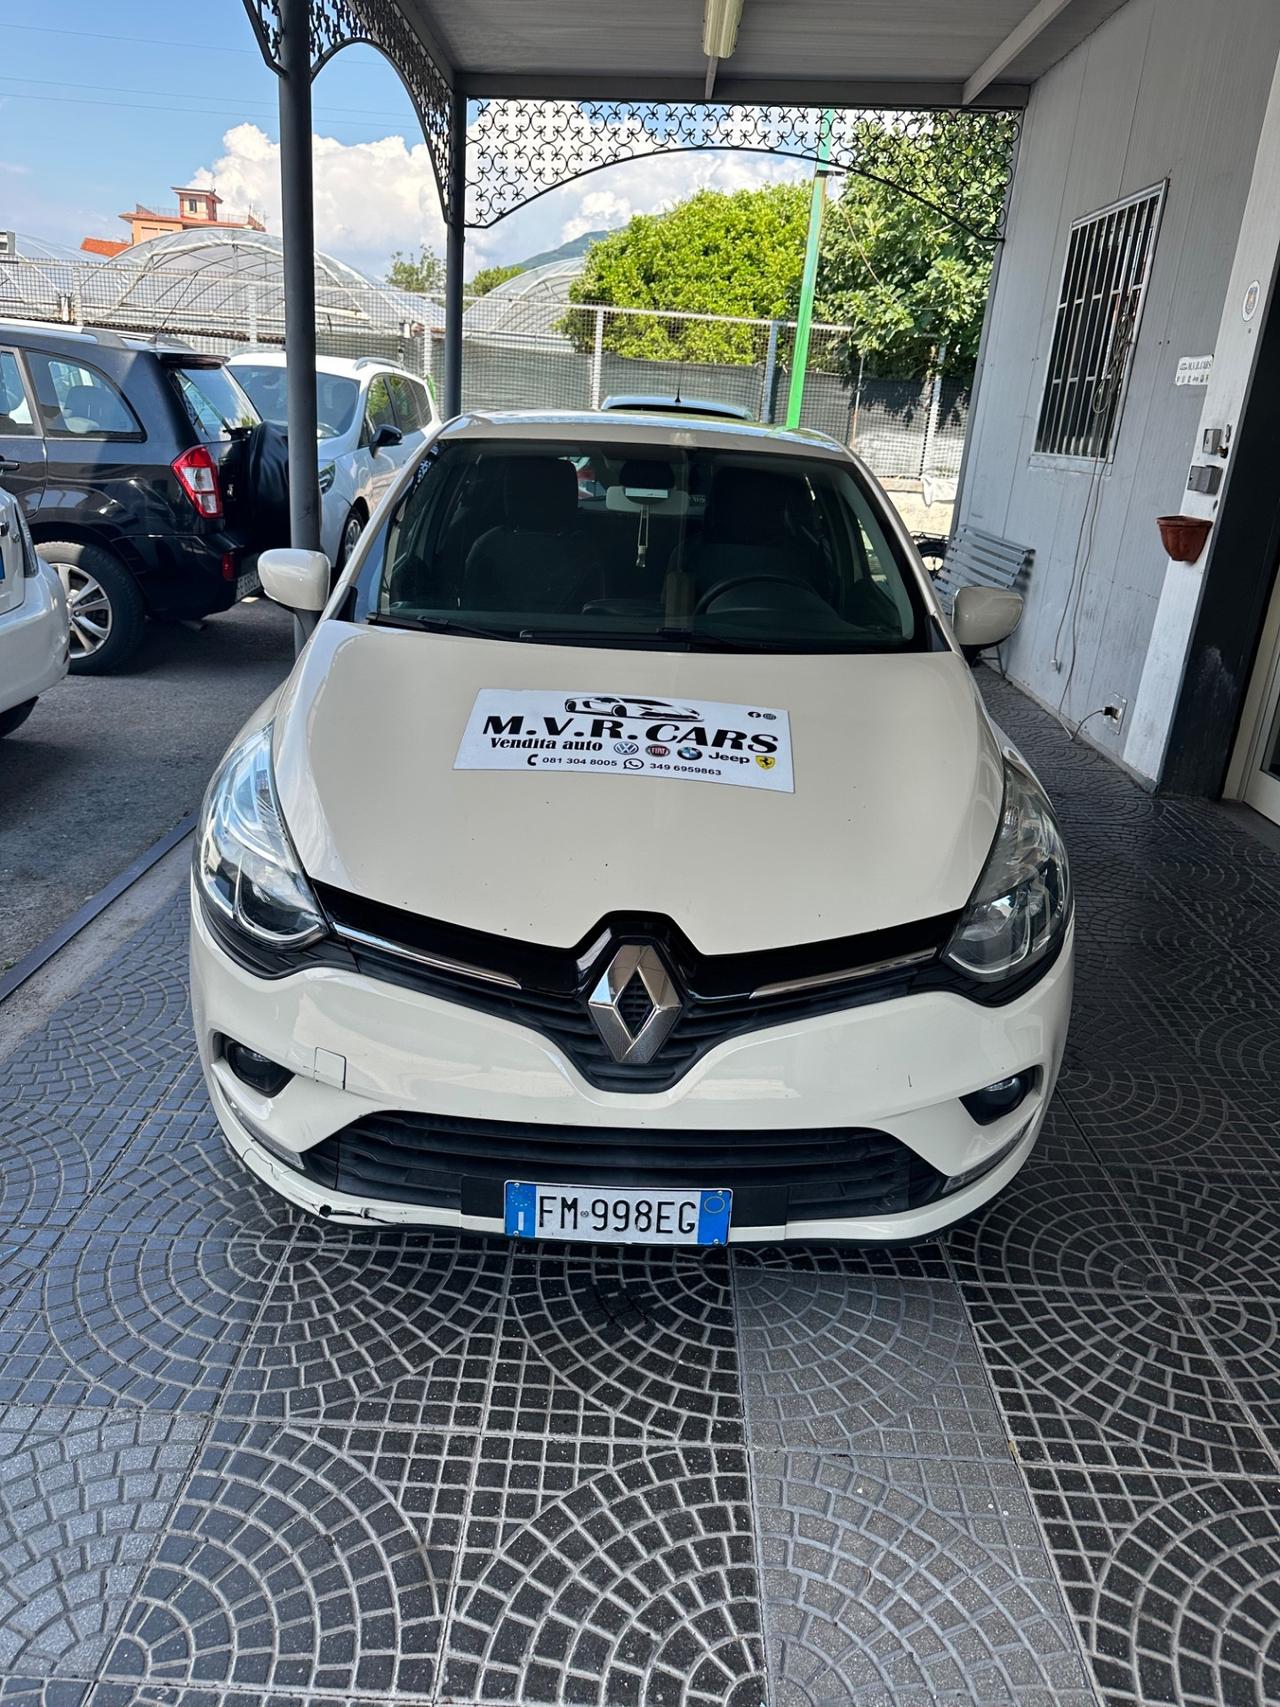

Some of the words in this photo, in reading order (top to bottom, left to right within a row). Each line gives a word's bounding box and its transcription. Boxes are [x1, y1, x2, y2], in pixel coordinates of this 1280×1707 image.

[491, 737, 556, 750] Vendita
[562, 740, 603, 752] auto
[590, 759, 618, 767] 8005
[708, 752, 750, 765] Jeep
[673, 765, 722, 776] 6959863
